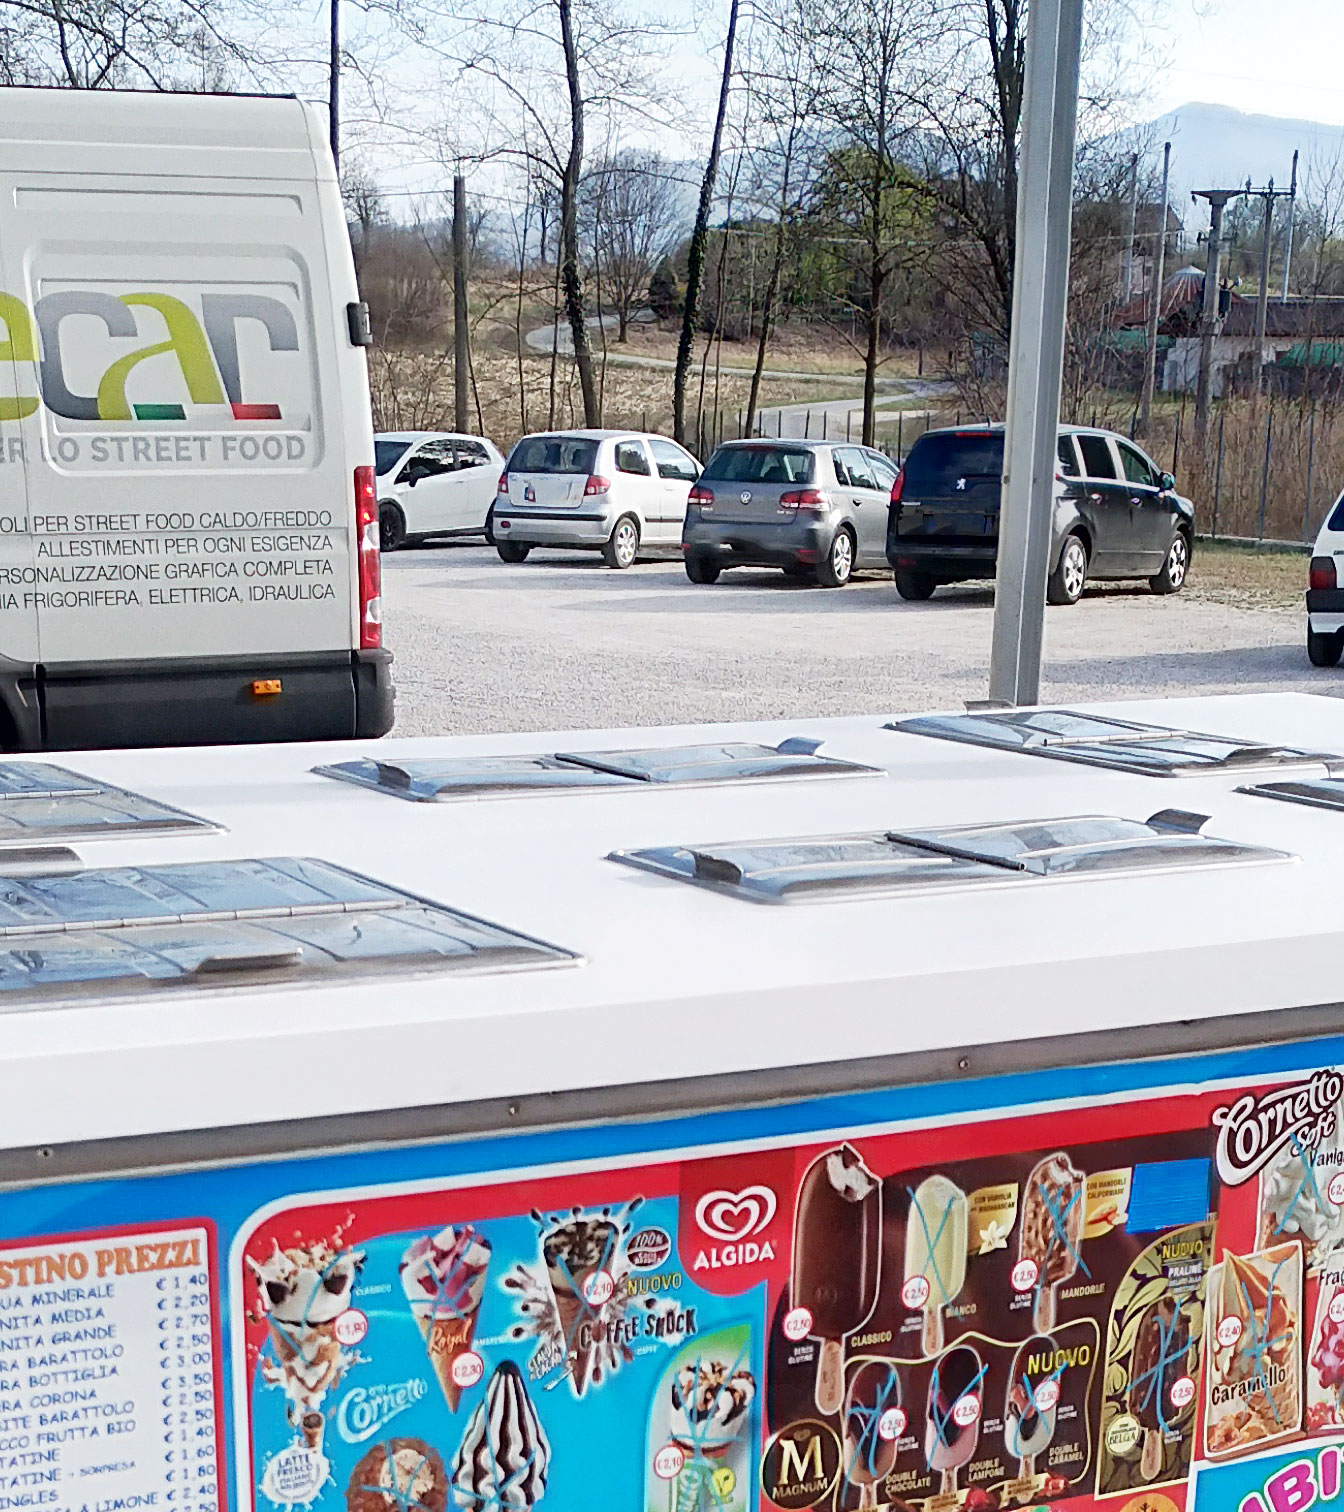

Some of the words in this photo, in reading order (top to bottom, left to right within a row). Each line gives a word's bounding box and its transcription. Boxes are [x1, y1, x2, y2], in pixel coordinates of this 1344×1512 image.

[40, 437, 79, 463] LO
[90, 436, 209, 462] STREET
[222, 435, 306, 460] FOOD
[33, 515, 69, 533] PER
[74, 513, 141, 531] STREET
[146, 512, 194, 529] FOOD
[200, 510, 332, 528] CALDO/FREDDO
[37, 539, 160, 559] ALLESTIMENTI
[164, 537, 199, 555] PER
[203, 537, 245, 553] OGNI
[251, 535, 333, 552] ESIGENZA
[164, 562, 238, 580] GRAFICA
[243, 559, 333, 578] COMPLETA
[149, 587, 244, 606] ELETTRICA,
[248, 584, 335, 602] IDRAULICA
[1212, 1071, 1342, 1186] Cornetto
[1291, 1109, 1336, 1156] Soft
[95, 1239, 202, 1278] PREZZI
[694, 1241, 775, 1270] ALGIDA
[1162, 1240, 1203, 1259] NUOVO
[32, 1283, 115, 1306] MINERALE
[627, 1272, 682, 1295] NUOVO
[1061, 1283, 1105, 1299] MANDORLE
[52, 1307, 105, 1324] MEDIA
[51, 1324, 117, 1344] GRANDE
[851, 1331, 892, 1347] CLASSICO
[28, 1344, 124, 1369] BARATTOLO
[1027, 1345, 1090, 1375] NUOVO
[29, 1365, 119, 1388] BOTTIGLIA
[1211, 1365, 1286, 1406] Caramello
[30, 1389, 98, 1409] CORONA
[39, 1401, 135, 1426] BARATTOLO
[37, 1426, 100, 1446] FRUTTA
[107, 1419, 136, 1435] BIO
[779, 1435, 824, 1485] M
[772, 1478, 828, 1500] MAGNUM
